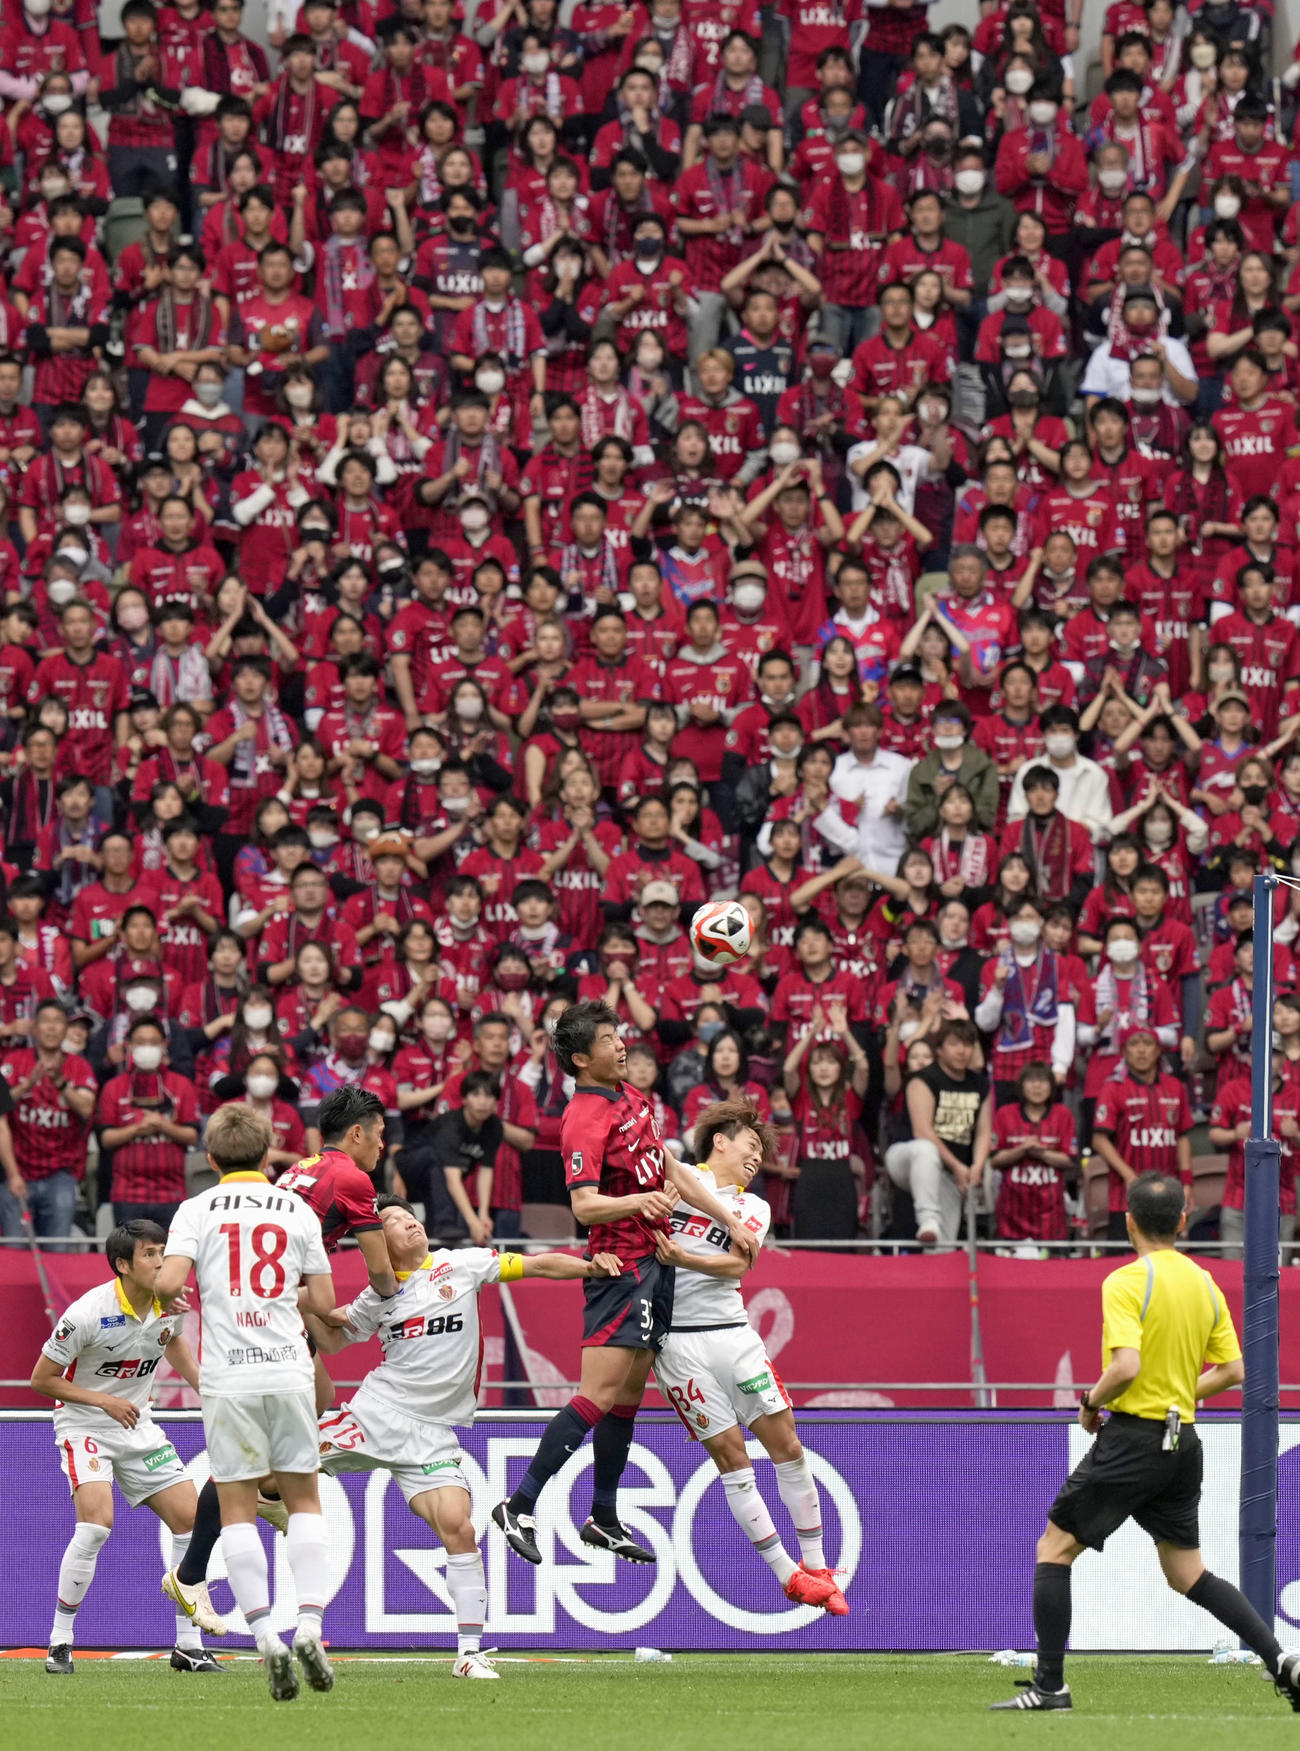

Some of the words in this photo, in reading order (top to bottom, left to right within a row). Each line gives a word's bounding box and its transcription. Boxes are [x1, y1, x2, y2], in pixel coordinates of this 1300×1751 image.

[1224, 435, 1275, 457] LIXIL
[1240, 666, 1278, 688] IXIL
[68, 709, 108, 730] IXIL
[553, 870, 600, 890] LIXIL
[484, 902, 519, 922] LIX
[19, 1104, 70, 1129] LIXIL
[1130, 1127, 1177, 1147] LIXIL
[1010, 1166, 1059, 1186] LIXIL
[219, 1222, 288, 1299] 18
[84, 1436, 98, 1454] 6
[333, 1422, 365, 1449] 15
